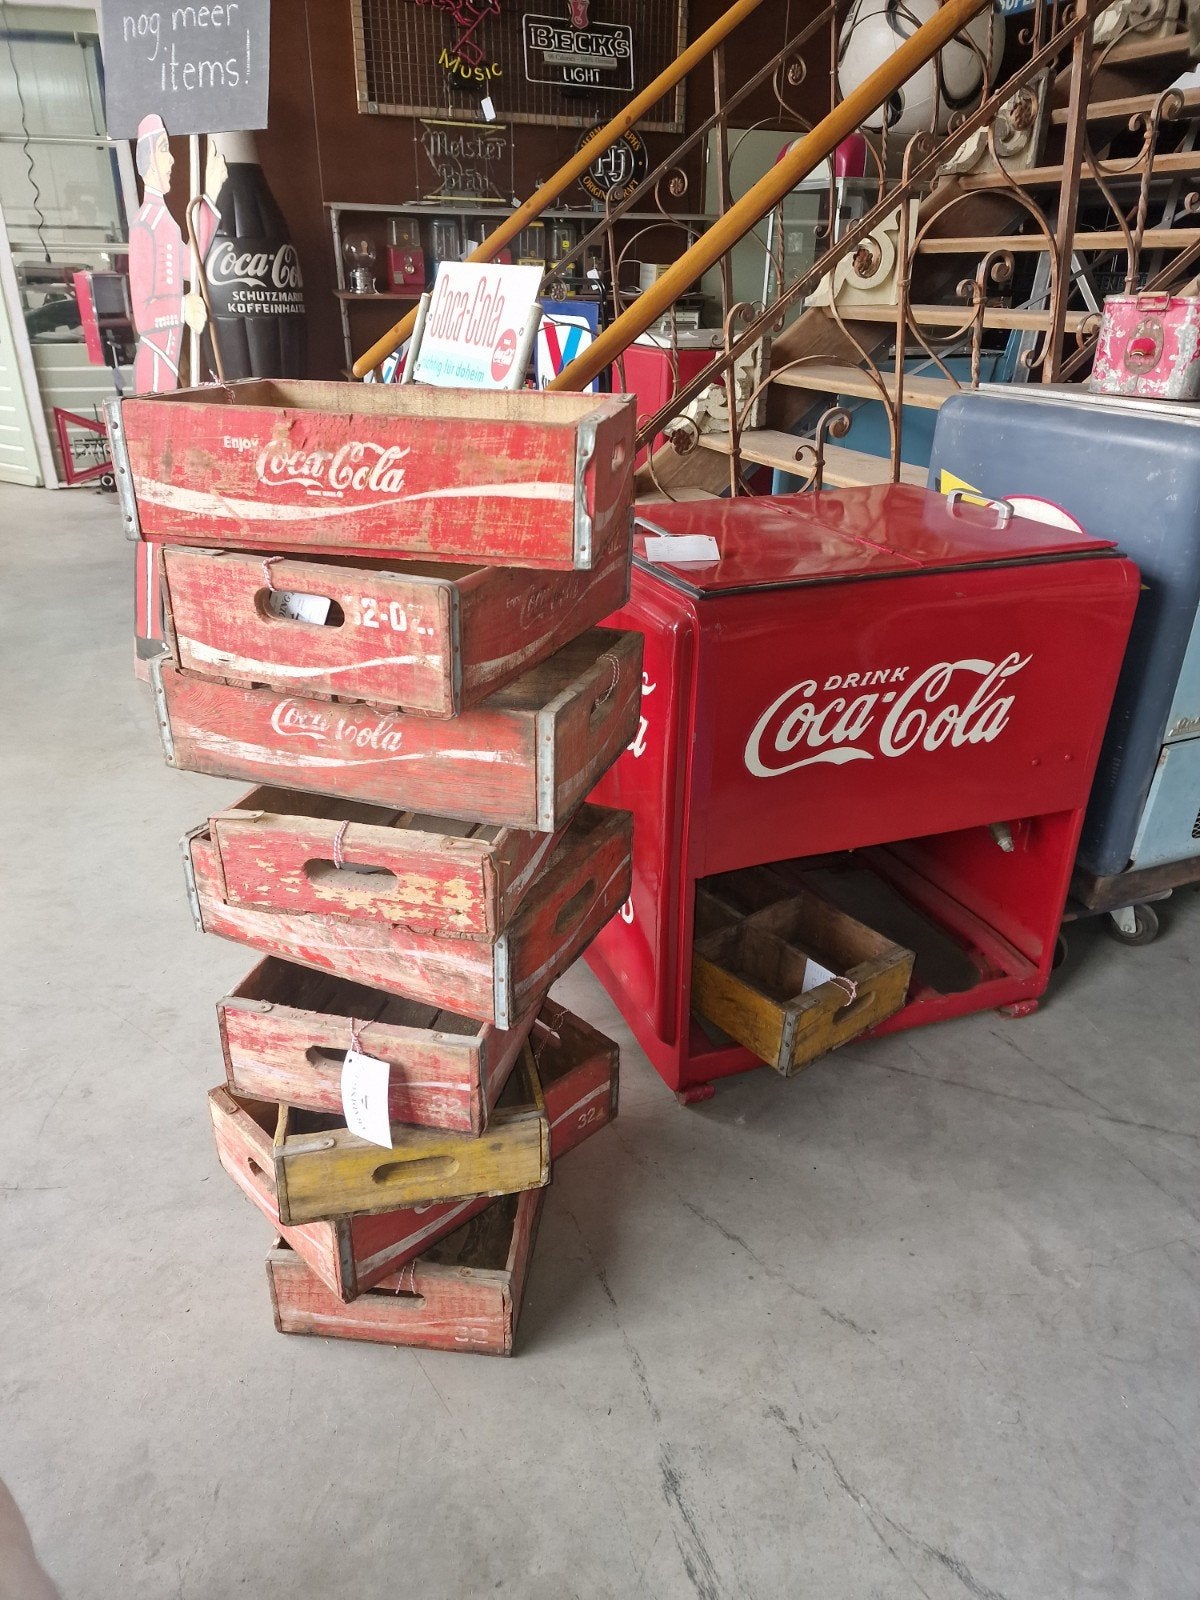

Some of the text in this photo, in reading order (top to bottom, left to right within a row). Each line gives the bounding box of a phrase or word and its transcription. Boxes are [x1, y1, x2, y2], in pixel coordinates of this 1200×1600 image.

[123, 3, 239, 61] nog meer
[528, 23, 630, 58] BECK'S
[161, 29, 250, 91] items!
[563, 66, 601, 83] LIGHT
[430, 273, 506, 349] Coca-Cola
[223, 434, 260, 452] Enjoy
[823, 666, 910, 692] DRINK
[744, 651, 1034, 778] Coca-Cola
